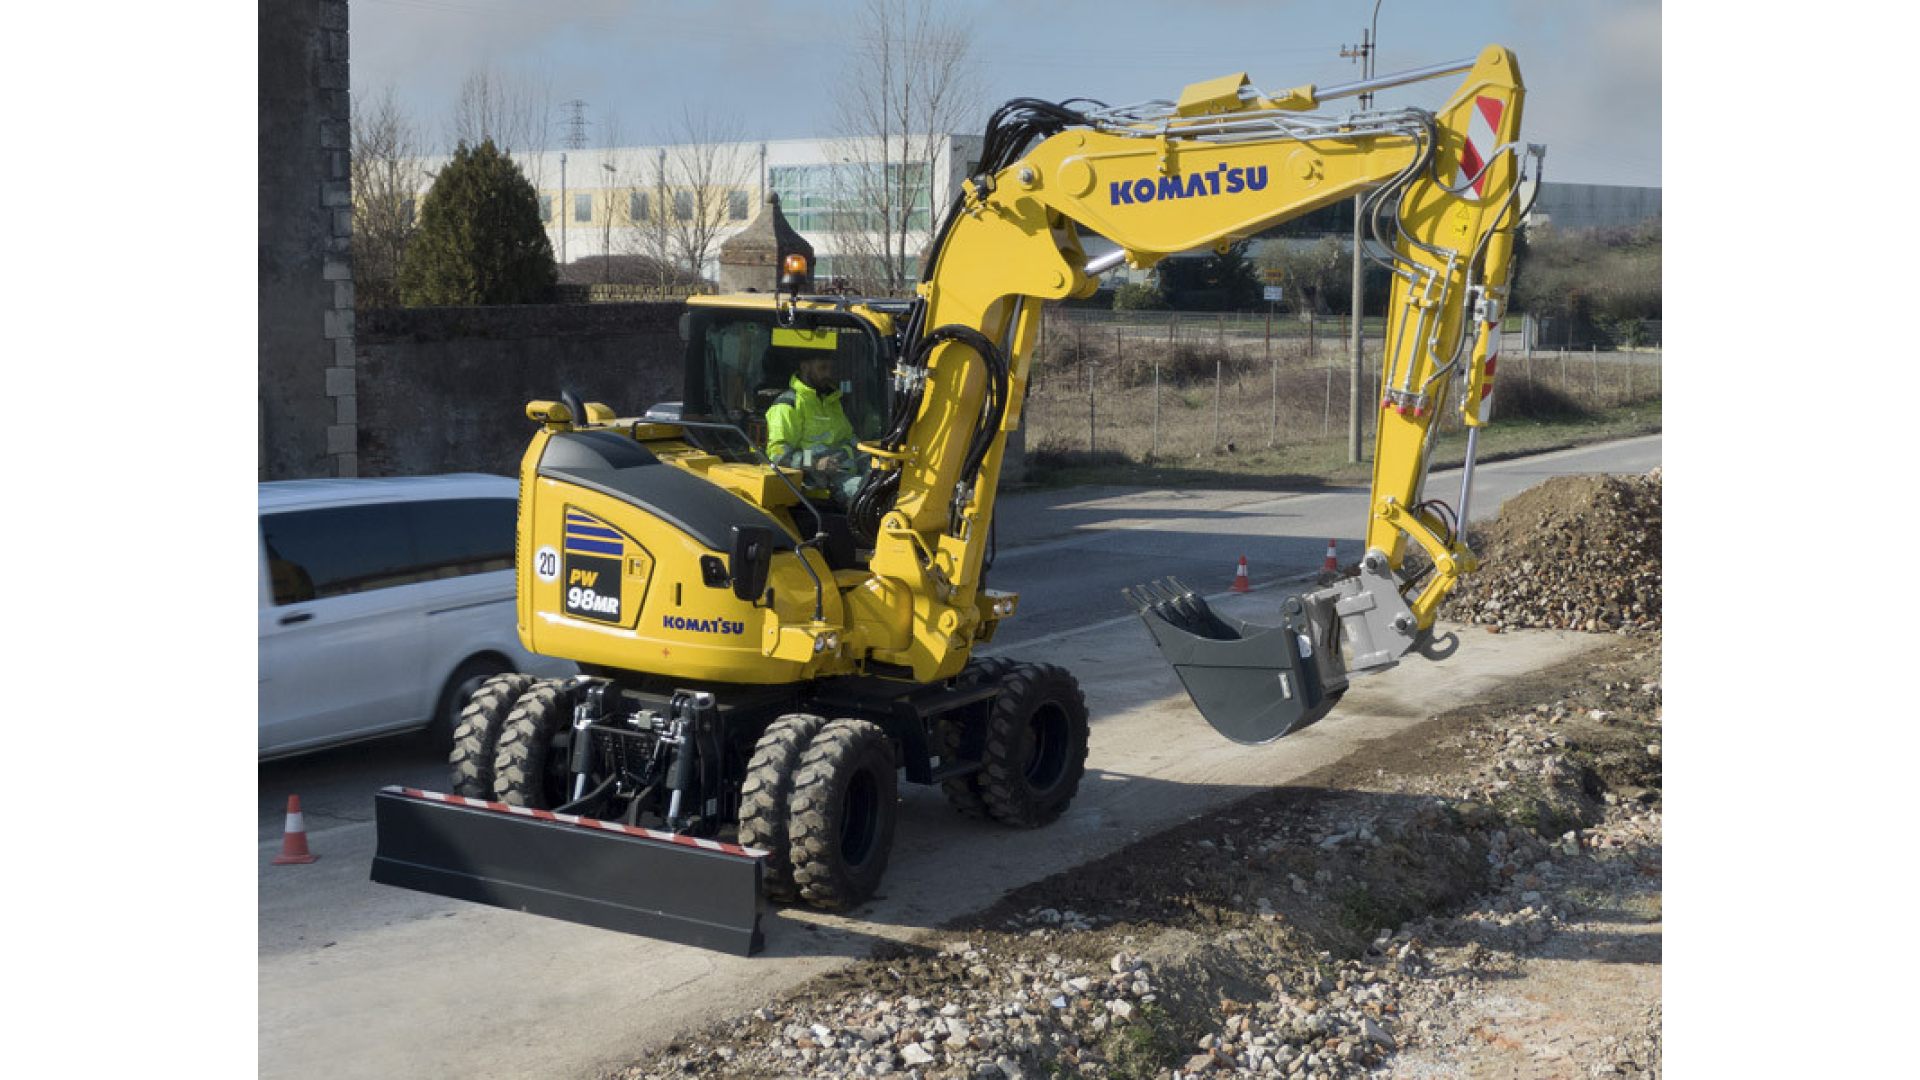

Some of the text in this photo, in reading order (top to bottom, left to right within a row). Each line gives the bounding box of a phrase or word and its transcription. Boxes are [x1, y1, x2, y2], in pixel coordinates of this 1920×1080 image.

[1110, 162, 1268, 206] KOMATSU
[539, 552, 556, 576] 20
[570, 569, 599, 586] PW
[567, 588, 618, 614] 98MR
[662, 615, 744, 634] KOMATSU
